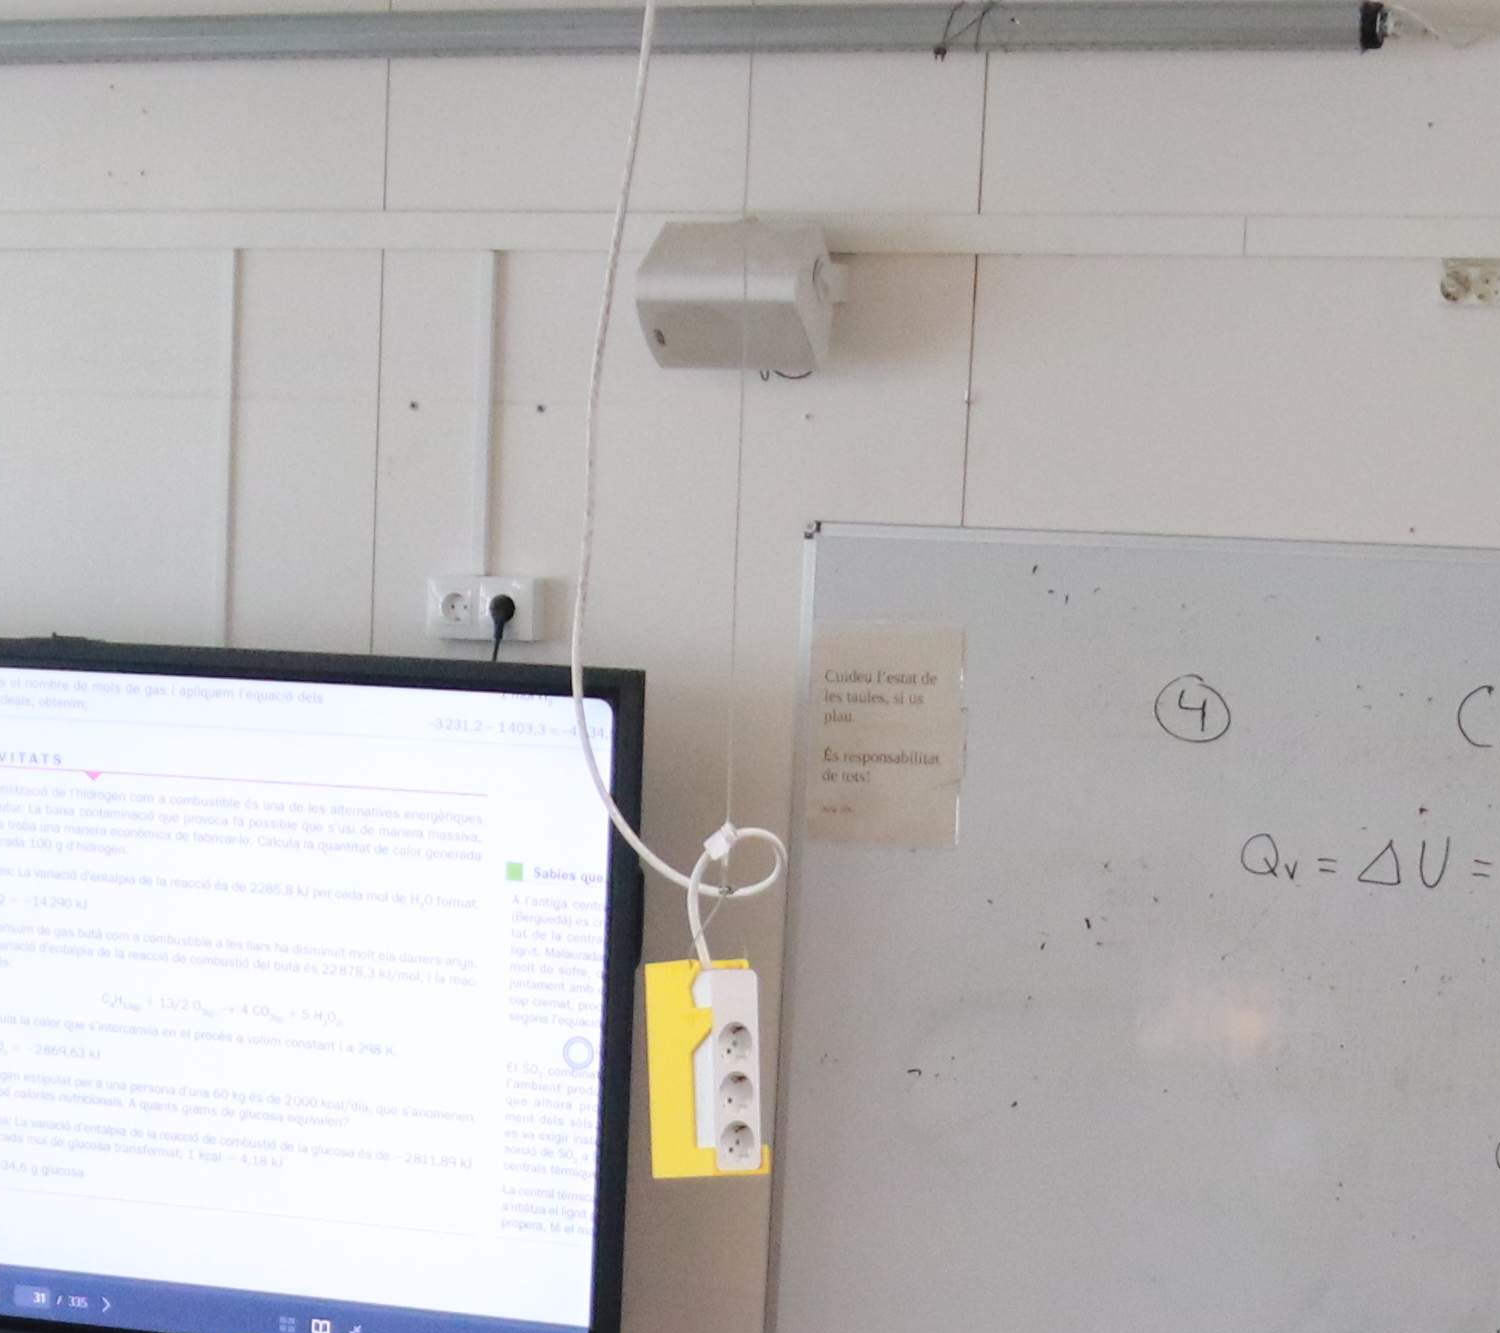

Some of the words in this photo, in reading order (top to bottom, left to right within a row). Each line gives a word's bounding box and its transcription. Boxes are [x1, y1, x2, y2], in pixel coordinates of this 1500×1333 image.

[824, 668, 873, 684] Cuideu
[921, 671, 938, 686] de
[823, 689, 842, 705] les
[823, 746, 839, 763] És
[843, 749, 940, 768] responsabilitat
[822, 767, 839, 784] de
[532, 865, 577, 882] Sabies
[32, 1291, 47, 1305] 31
